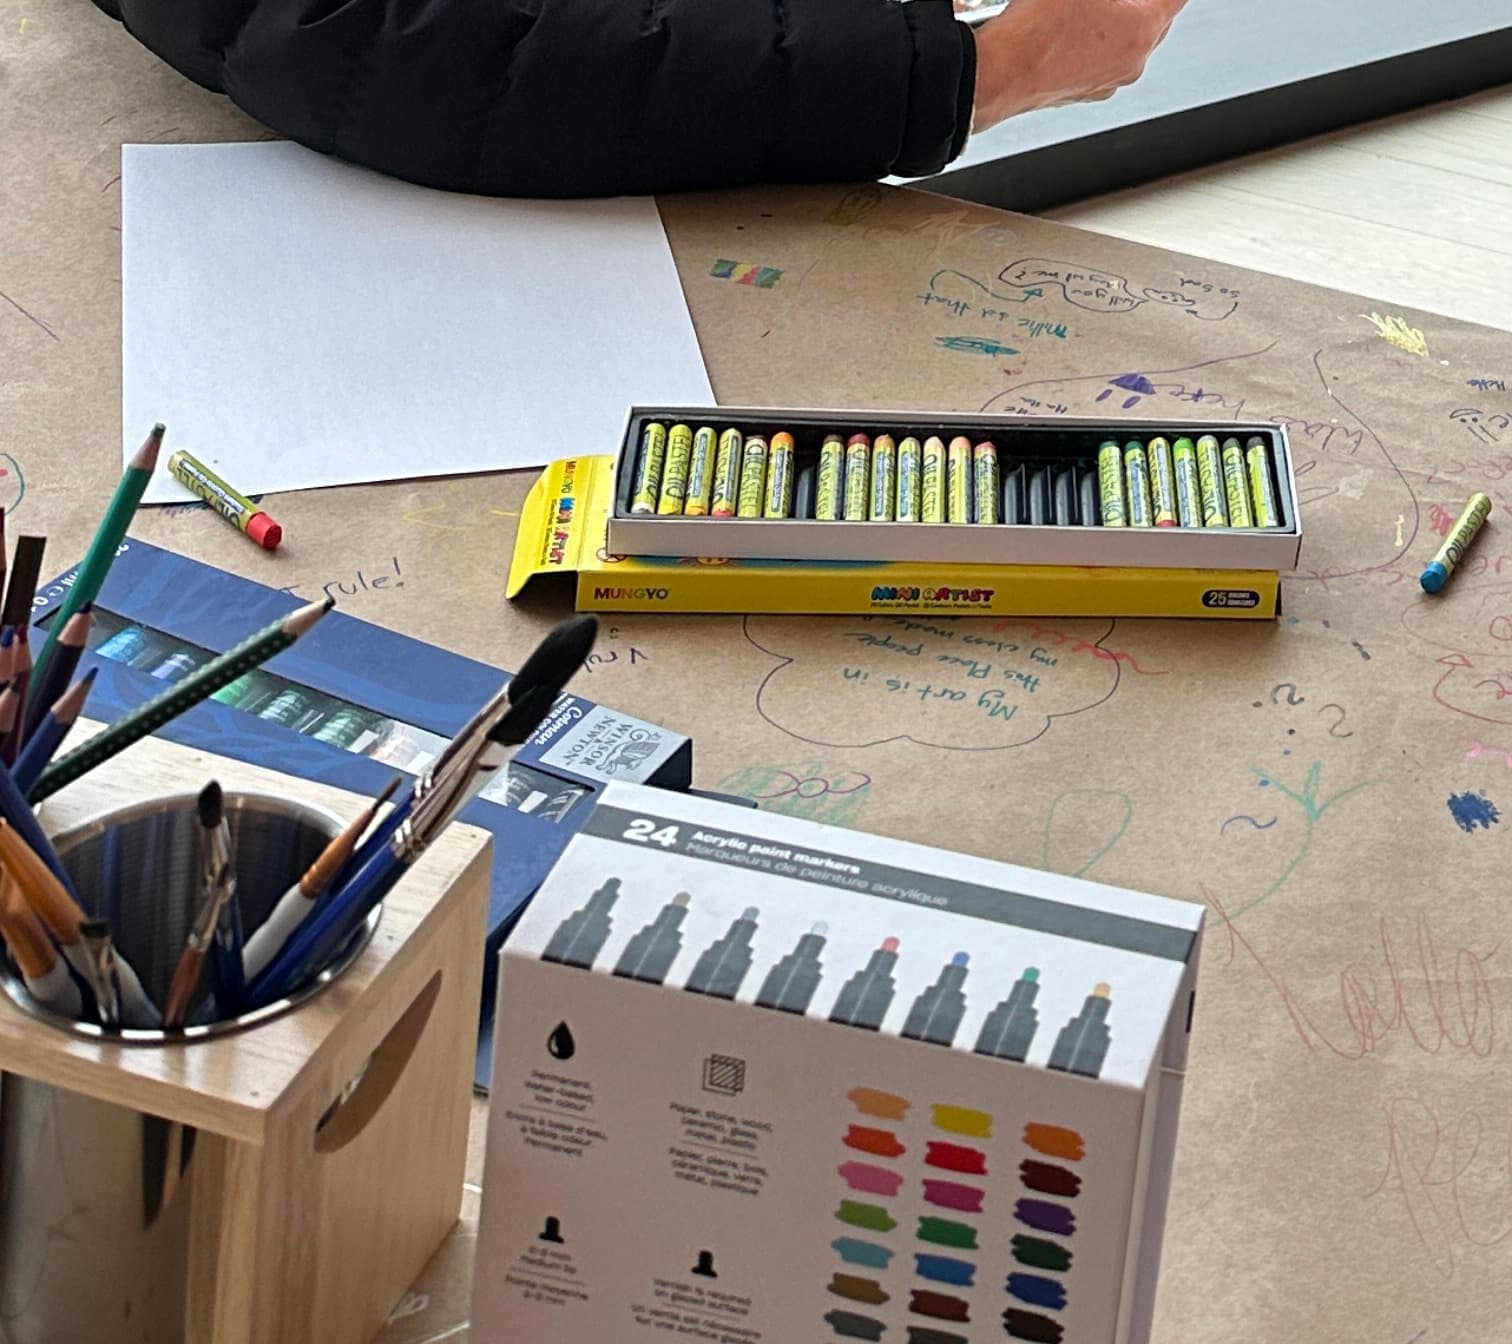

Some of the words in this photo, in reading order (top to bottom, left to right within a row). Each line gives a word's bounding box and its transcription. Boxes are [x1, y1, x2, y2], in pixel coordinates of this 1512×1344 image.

[593, 587, 670, 600] MUNGYO
[922, 586, 996, 602] ARTIST
[842, 667, 870, 685] in
[885, 677, 911, 693] is
[916, 683, 967, 701] art
[976, 688, 1019, 721] My
[580, 722, 634, 767] WINSOR
[622, 816, 680, 849] 24
[690, 830, 749, 855] Acrylic
[748, 842, 792, 863] paint
[793, 851, 862, 876] markers
[684, 841, 773, 871] Marqueurs
[774, 859, 797, 874] de
[798, 865, 870, 891] peinture
[871, 882, 949, 909] acrylique
